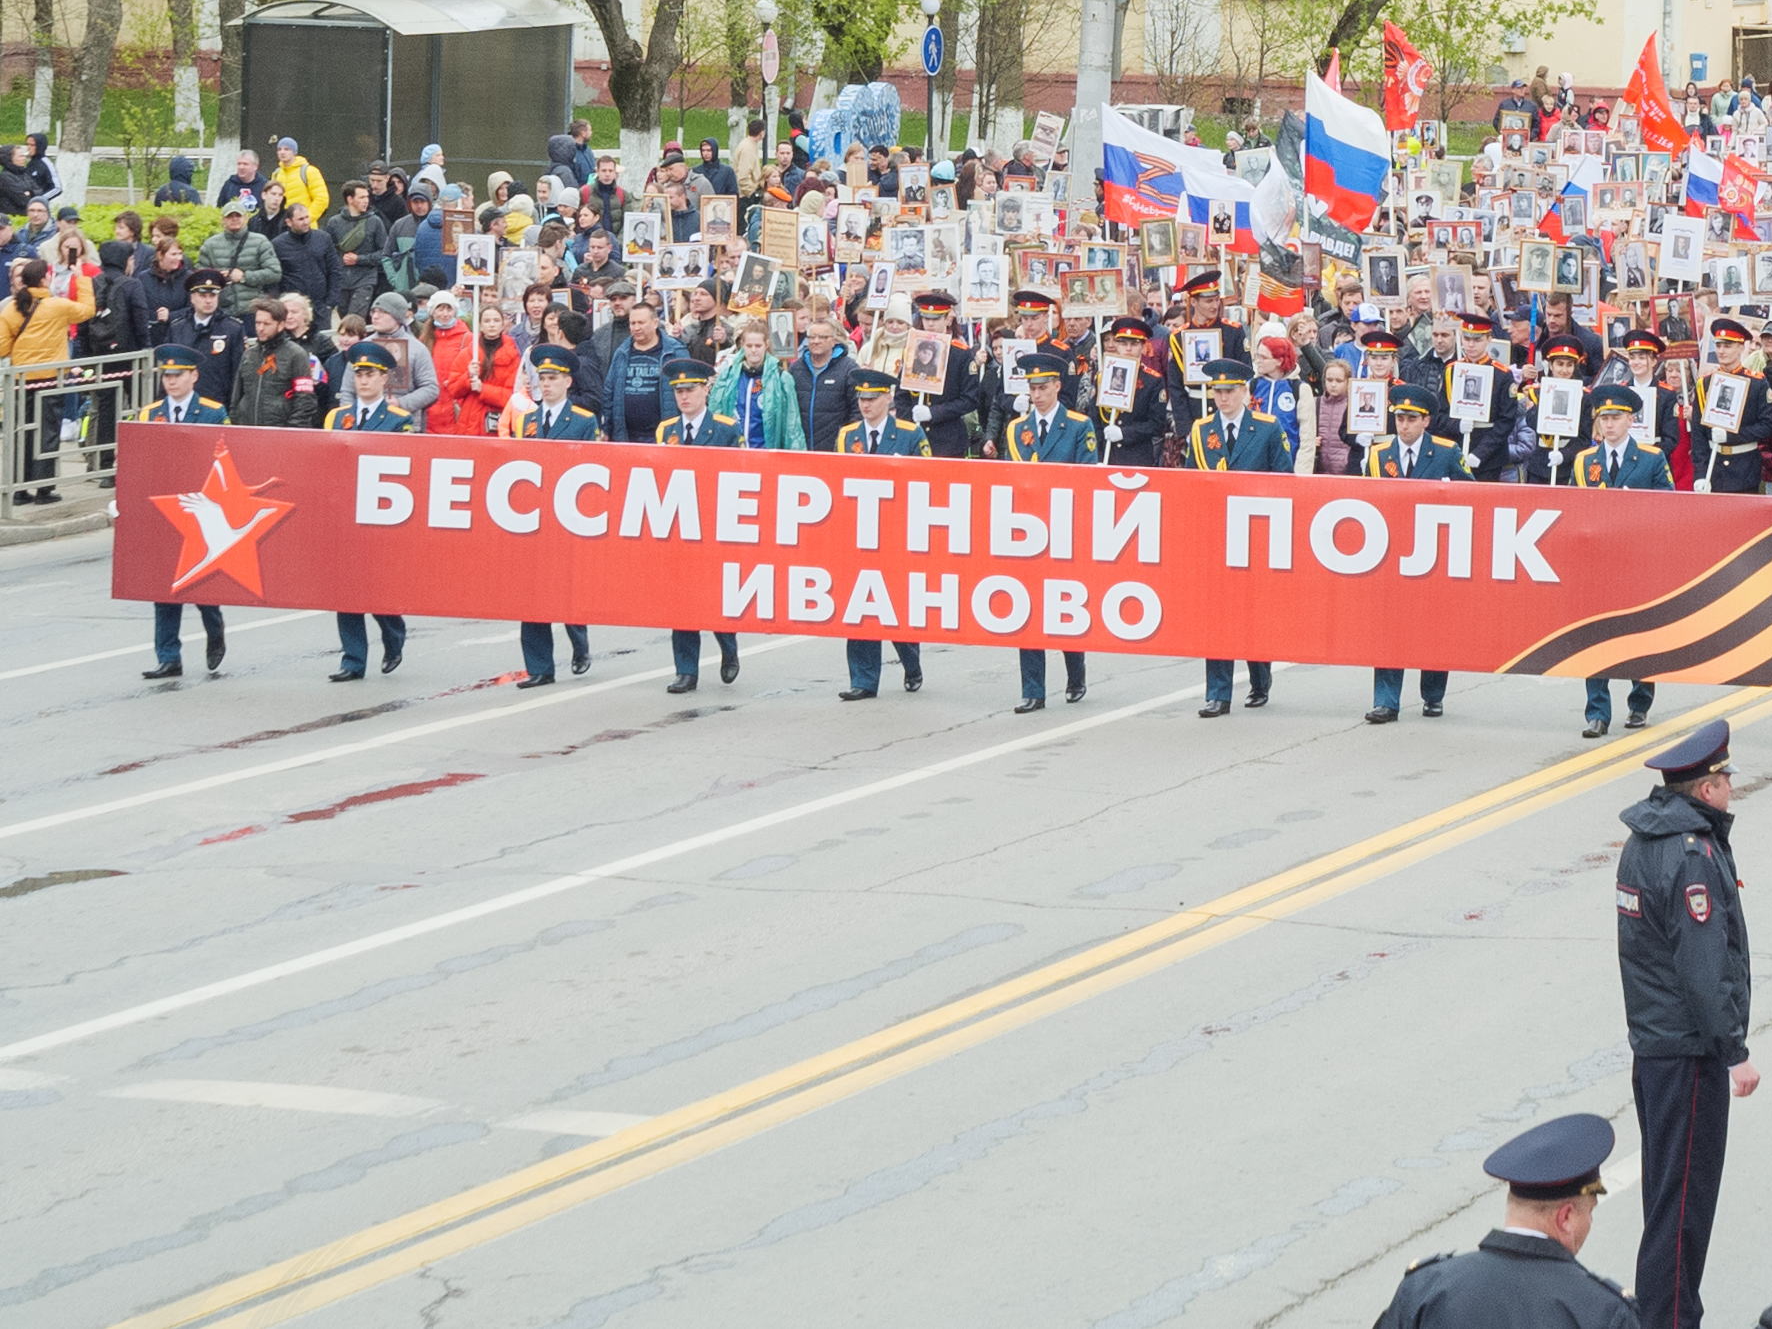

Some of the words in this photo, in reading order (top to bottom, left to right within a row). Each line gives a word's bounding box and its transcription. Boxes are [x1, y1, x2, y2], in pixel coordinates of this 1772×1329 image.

[355, 454, 1162, 564] БЕССМЕРТНЫЙ
[1226, 494, 1563, 583] ПОЛК
[721, 562, 1163, 642] ИВАНОВО
